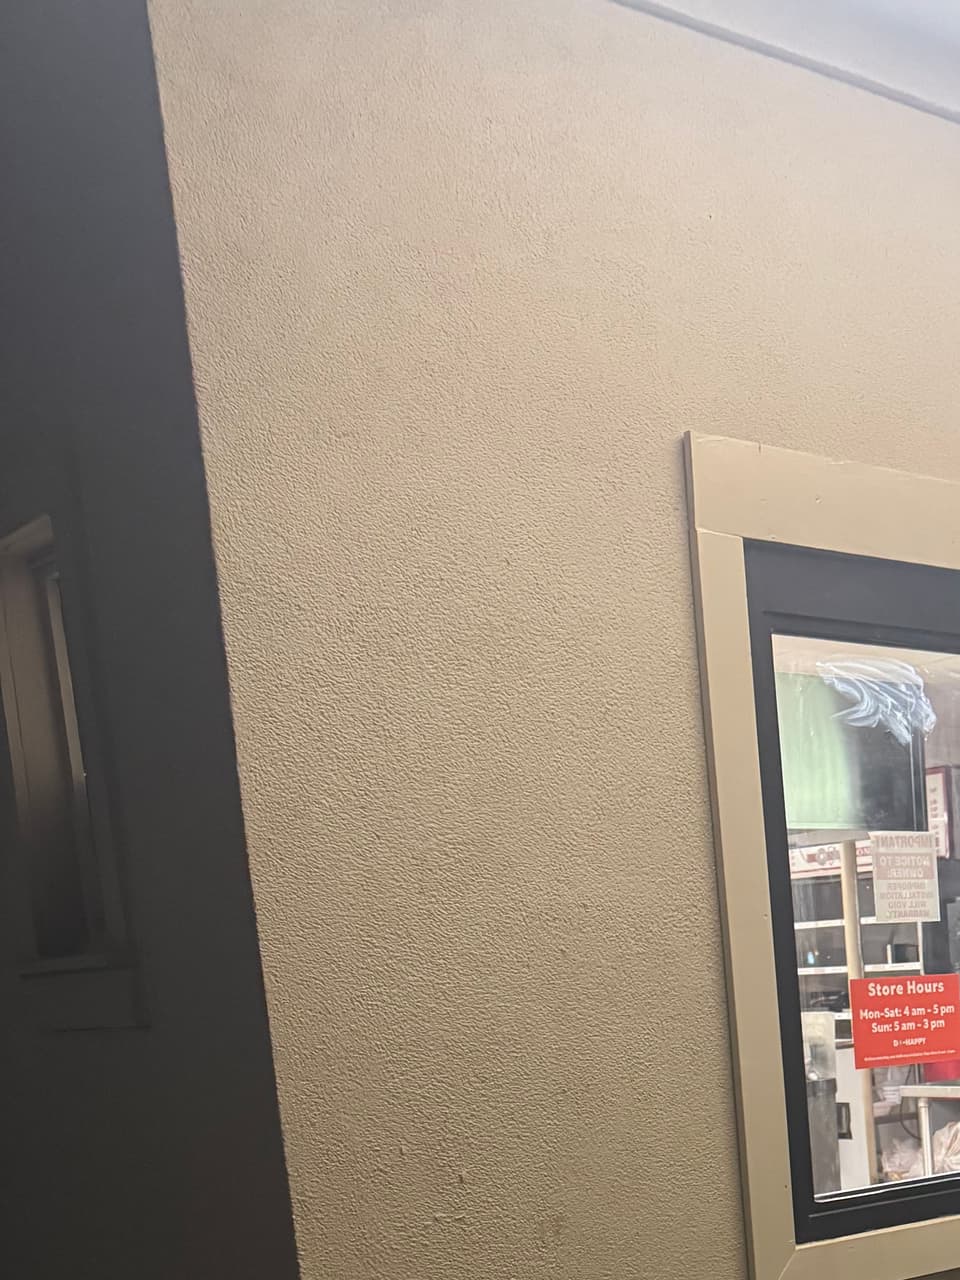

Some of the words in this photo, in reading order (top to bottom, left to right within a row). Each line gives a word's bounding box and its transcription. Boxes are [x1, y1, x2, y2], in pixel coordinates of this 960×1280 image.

[867, 982, 904, 997] Store
[906, 980, 945, 995] Hours
[859, 1007, 902, 1020] Mon-Sat:
[903, 1005, 910, 1017] 4
[911, 1006, 926, 1016] am
[933, 1004, 939, 1014] 5
[940, 1004, 955, 1016] pm
[871, 1021, 893, 1033] Sun:
[894, 1020, 900, 1031] 5
[901, 1021, 916, 1031] am
[923, 1018, 929, 1029] 3
[930, 1019, 945, 1031] pm
